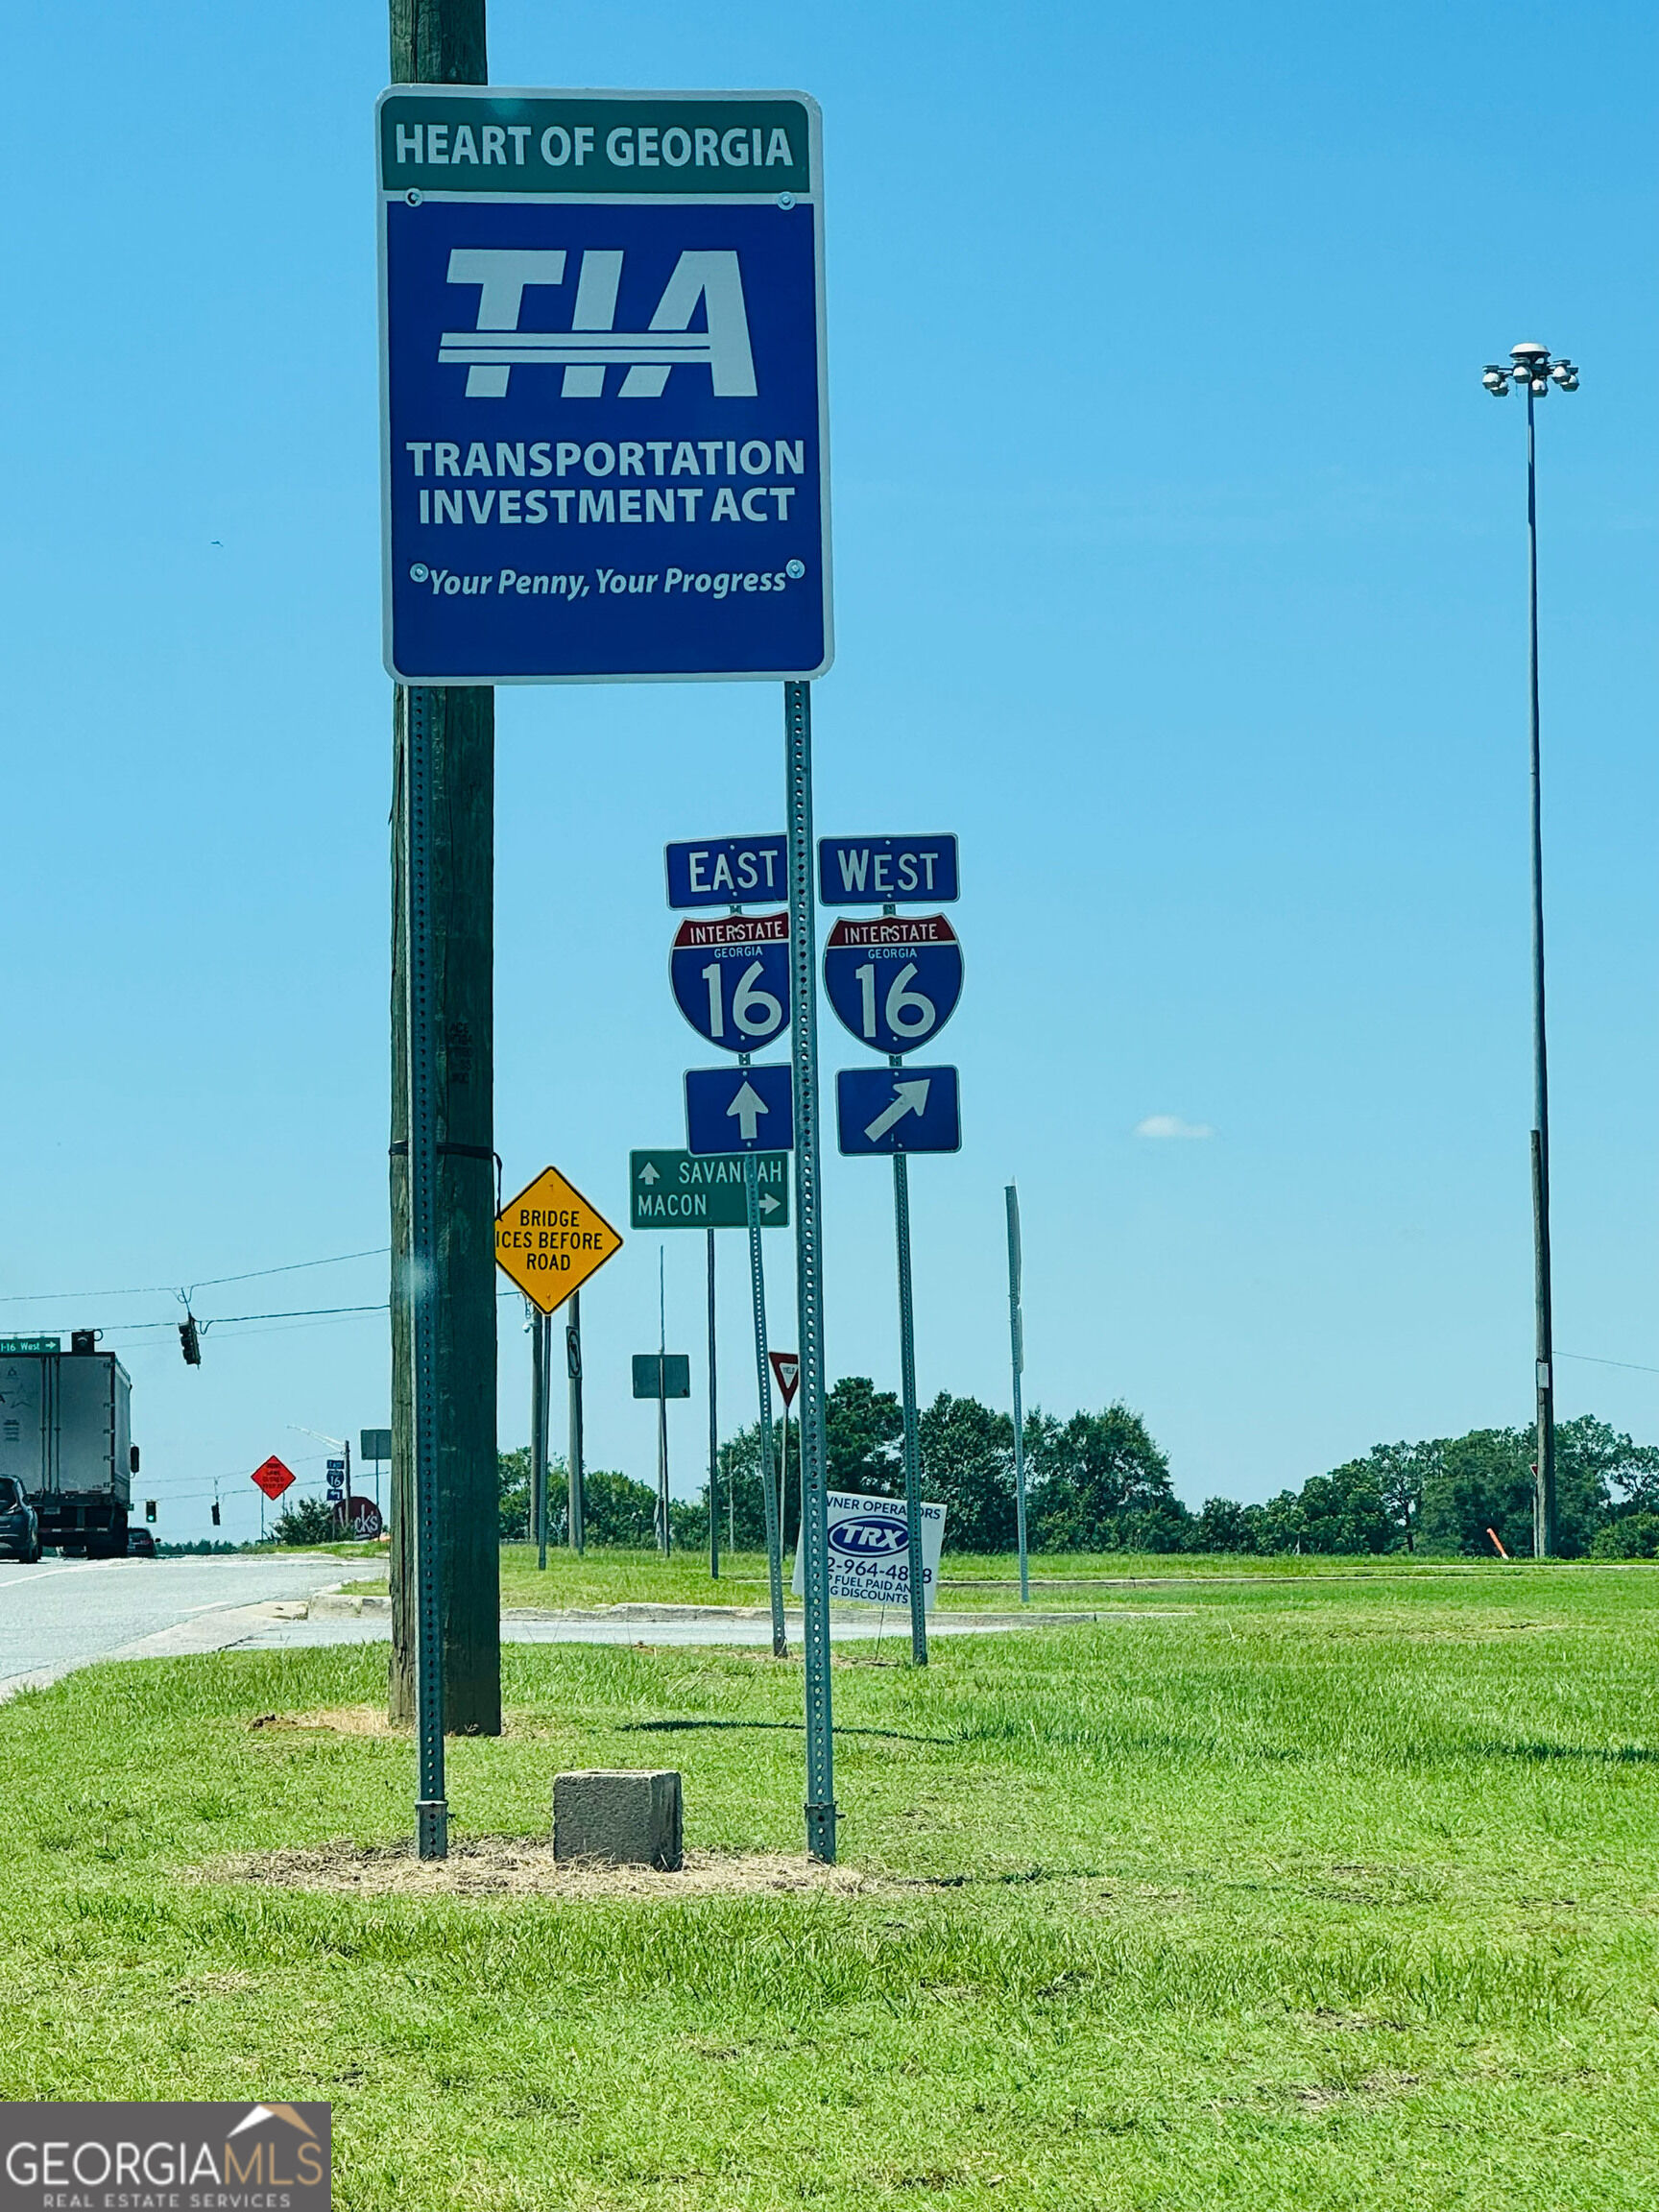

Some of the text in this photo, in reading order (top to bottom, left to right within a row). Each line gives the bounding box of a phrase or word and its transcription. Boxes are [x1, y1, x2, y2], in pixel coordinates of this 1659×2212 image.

[396, 124, 794, 167] HEART OF GEORGIA
[437, 248, 759, 399] TIA
[406, 439, 805, 477] TRANSPORTATION
[419, 487, 796, 525] INVESTMENT ACT
[429, 567, 787, 601] Your Penny, Your Progress
[688, 849, 779, 894] EAST
[837, 849, 939, 892] WEST
[689, 921, 785, 945] INTERSTATE
[844, 923, 939, 944] INTERSTATE
[713, 946, 764, 959] GEORGIA
[868, 948, 919, 960] GEORGIA
[702, 960, 782, 1038] 16
[855, 961, 937, 1039] 16
[678, 1160, 782, 1184] SAVANAH
[637, 1193, 708, 1217] MACON
[519, 1209, 581, 1228] BRIDGE
[495, 1230, 604, 1251] ICES BEFORE
[526, 1252, 571, 1271] ROAD
[329, 1475, 342, 1487] 16
[827, 1496, 941, 1521] NER OPERARS
[842, 1524, 904, 1551] TRX
[834, 1575, 863, 1588] FUEL
[865, 1578, 893, 1591] PAID
[895, 1582, 912, 1595] AN
[841, 1586, 908, 1604] DISCOUNTS
